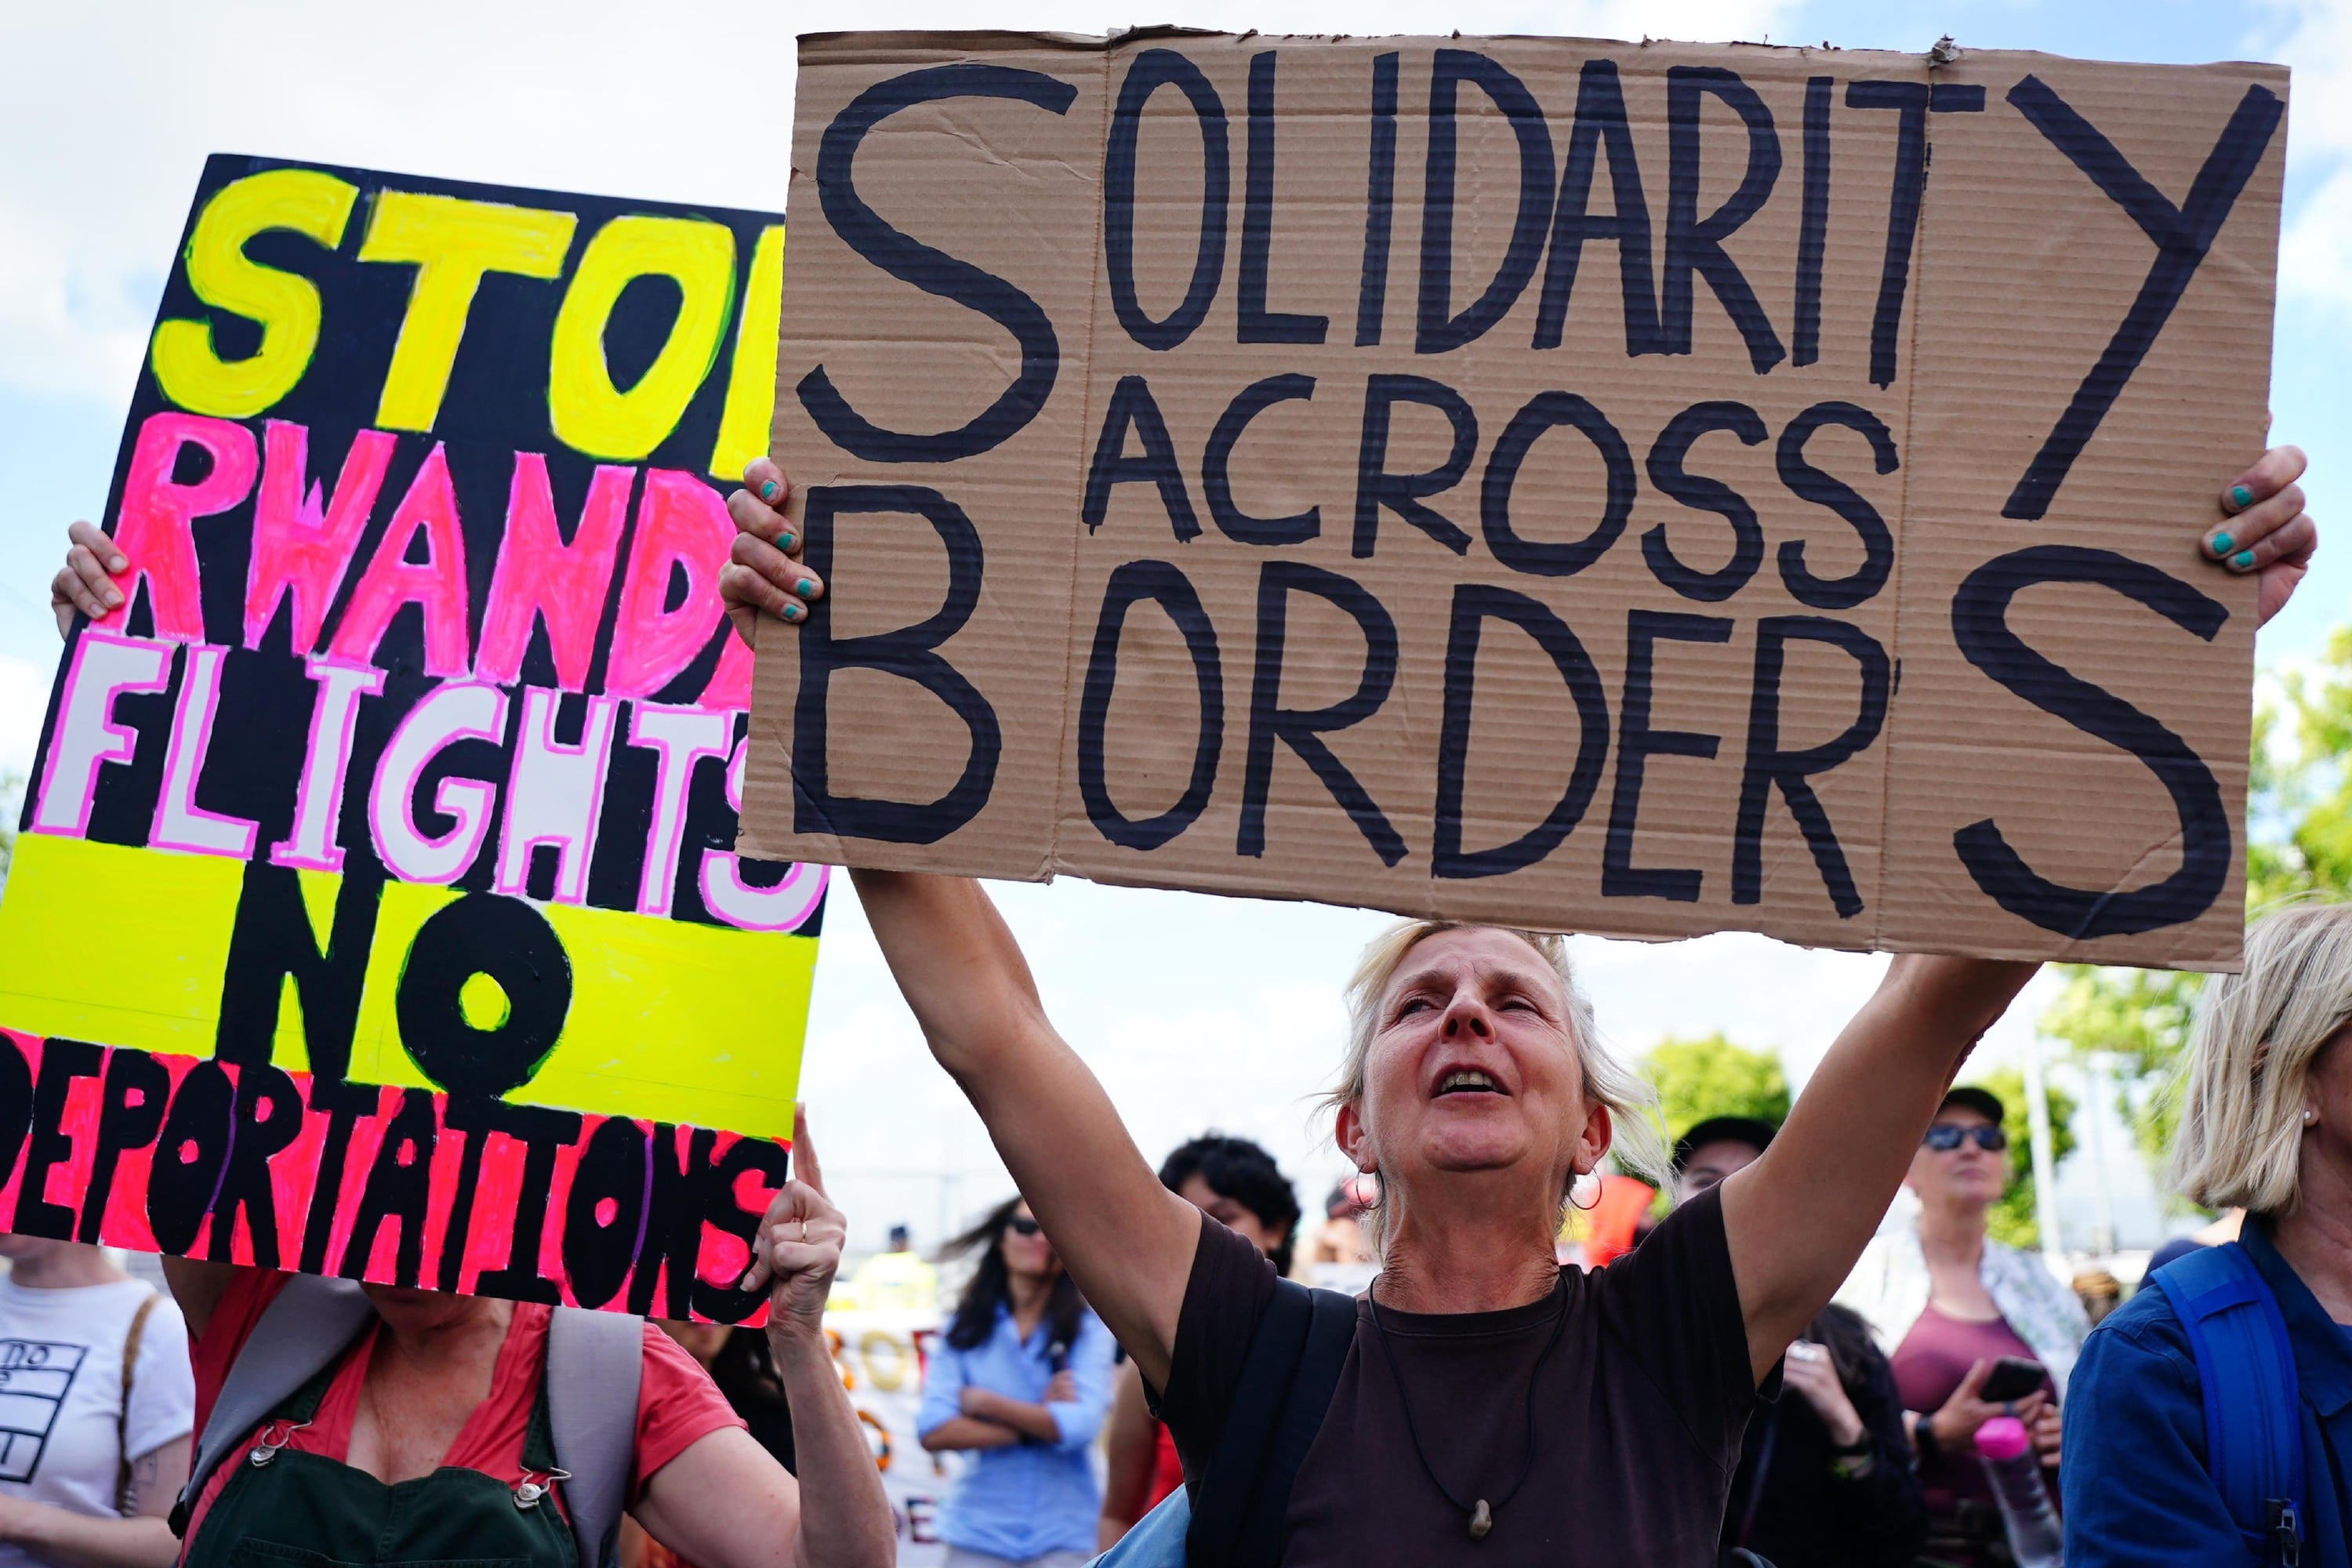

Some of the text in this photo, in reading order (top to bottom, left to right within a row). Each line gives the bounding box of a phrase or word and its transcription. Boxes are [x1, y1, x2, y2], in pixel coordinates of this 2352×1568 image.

[796, 47, 2285, 521] SOLIDARITY
[1082, 373, 1900, 608] ACROSS
[793, 484, 2232, 938] BORDERS
[216, 858, 574, 1099] NO
